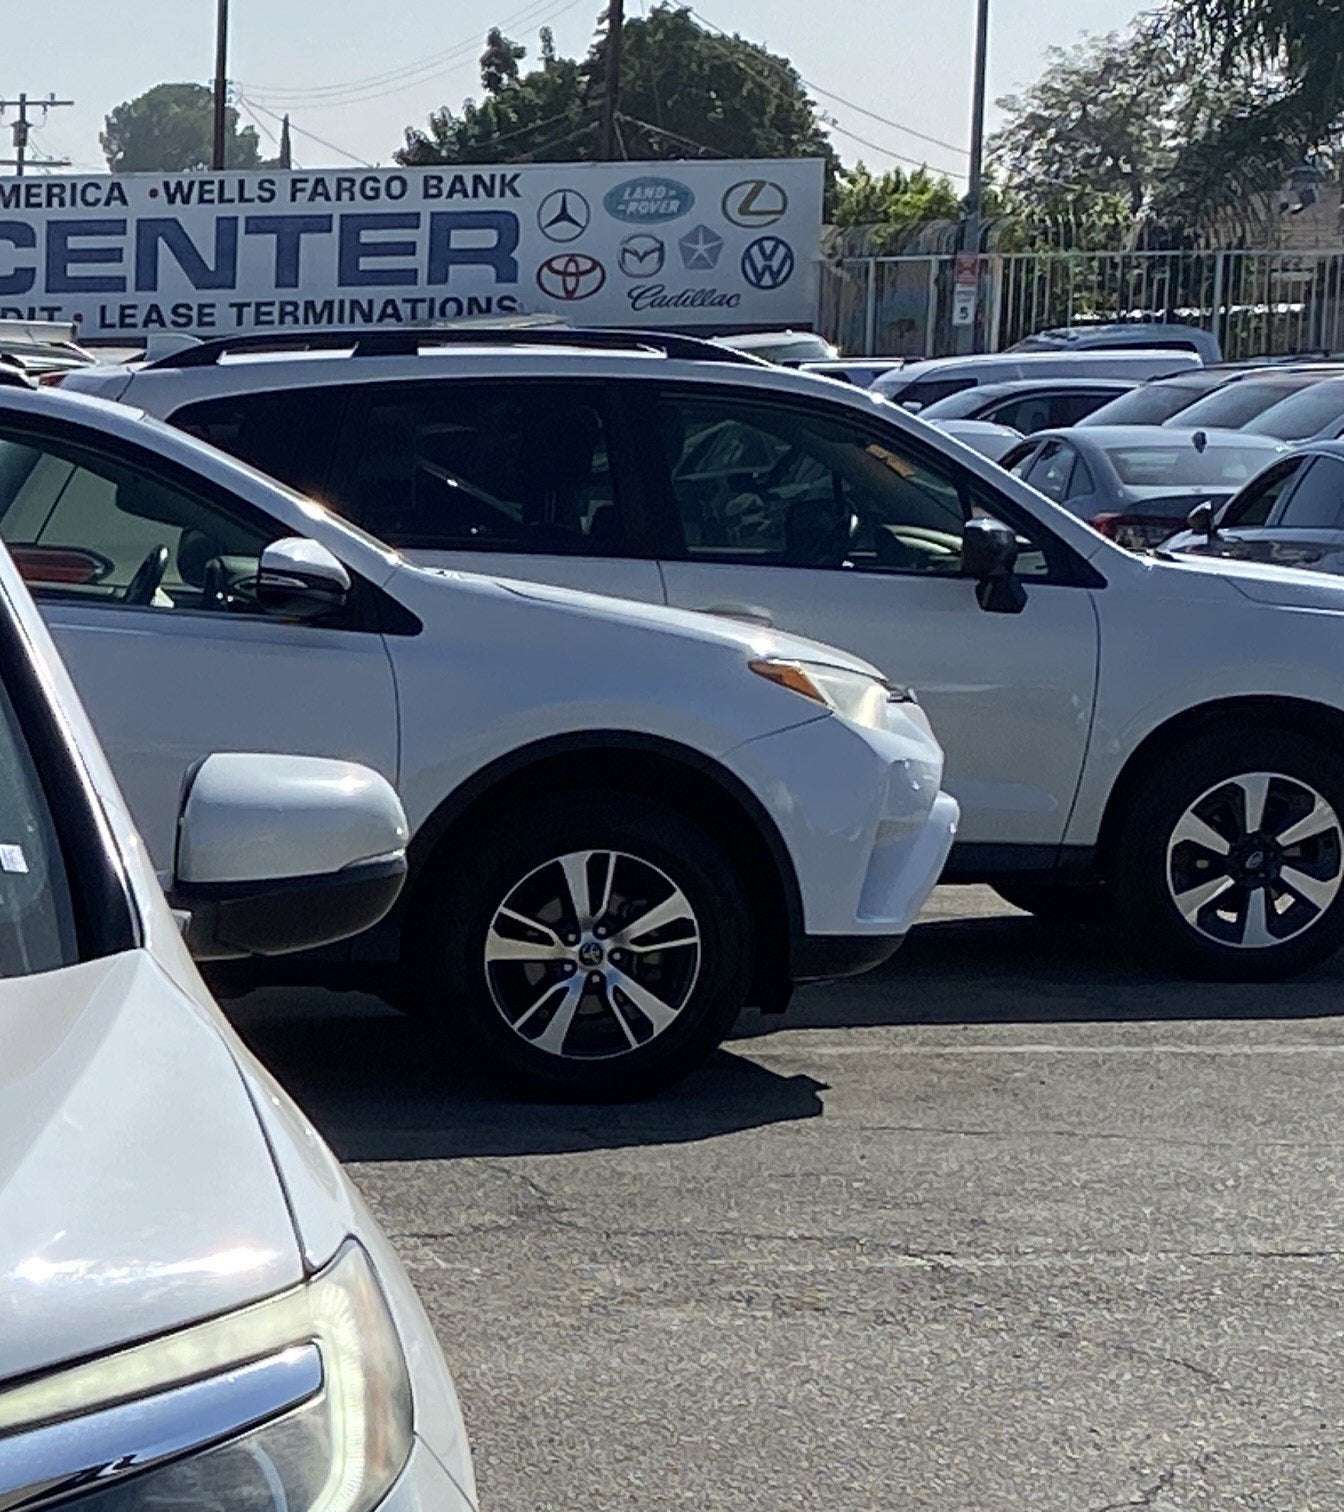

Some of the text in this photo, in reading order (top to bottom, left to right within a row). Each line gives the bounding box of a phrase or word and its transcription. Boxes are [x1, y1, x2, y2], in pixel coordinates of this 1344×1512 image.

[162, 178, 276, 206] WELLS
[289, 175, 409, 203] FARGO
[422, 172, 523, 200] BANK
[98, 303, 217, 329] LEASE
[228, 295, 519, 328] TERMINATIONS
[626, 283, 742, 312] Cadillac
